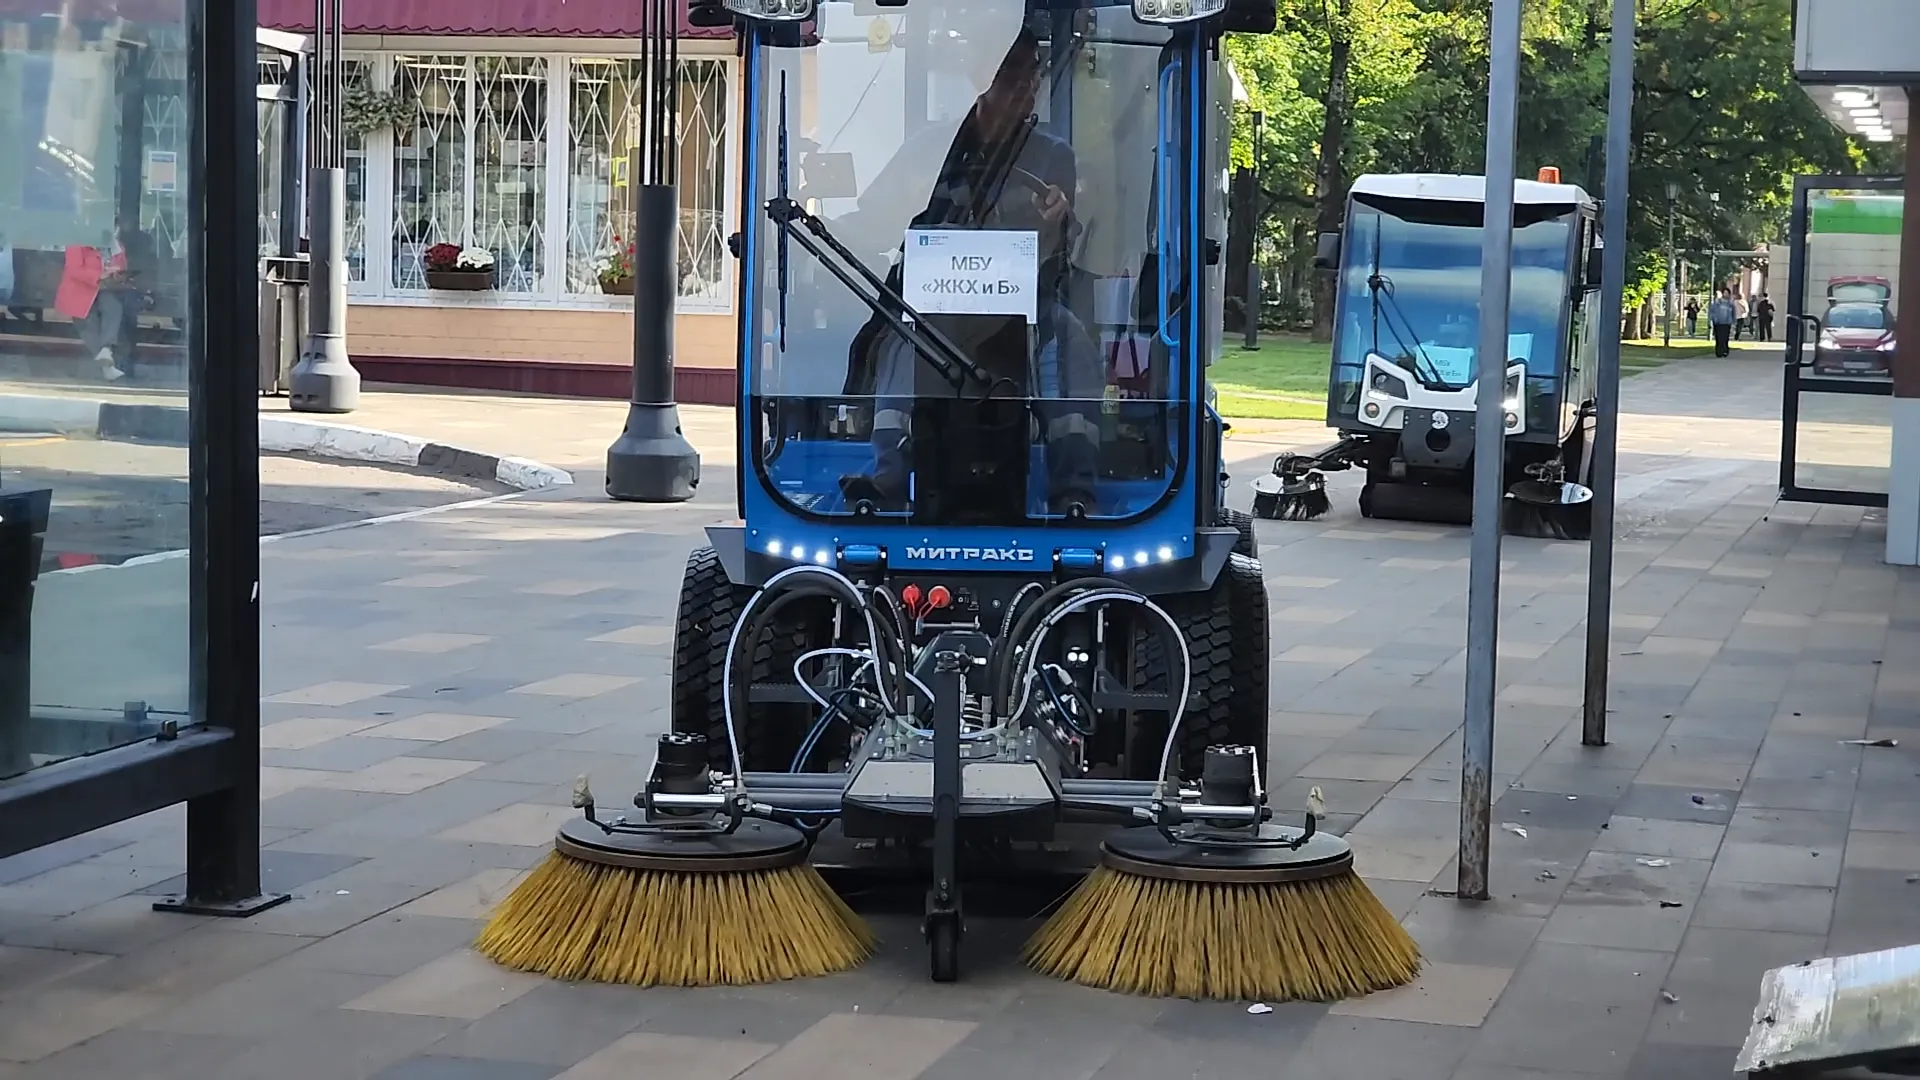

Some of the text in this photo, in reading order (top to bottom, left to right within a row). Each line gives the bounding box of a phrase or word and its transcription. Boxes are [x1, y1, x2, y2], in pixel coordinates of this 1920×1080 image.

[951, 256, 992, 271] МБУ
[921, 279, 1020, 295] «ЖКХ и Б»
[905, 547, 1034, 561] МИТРАКС
